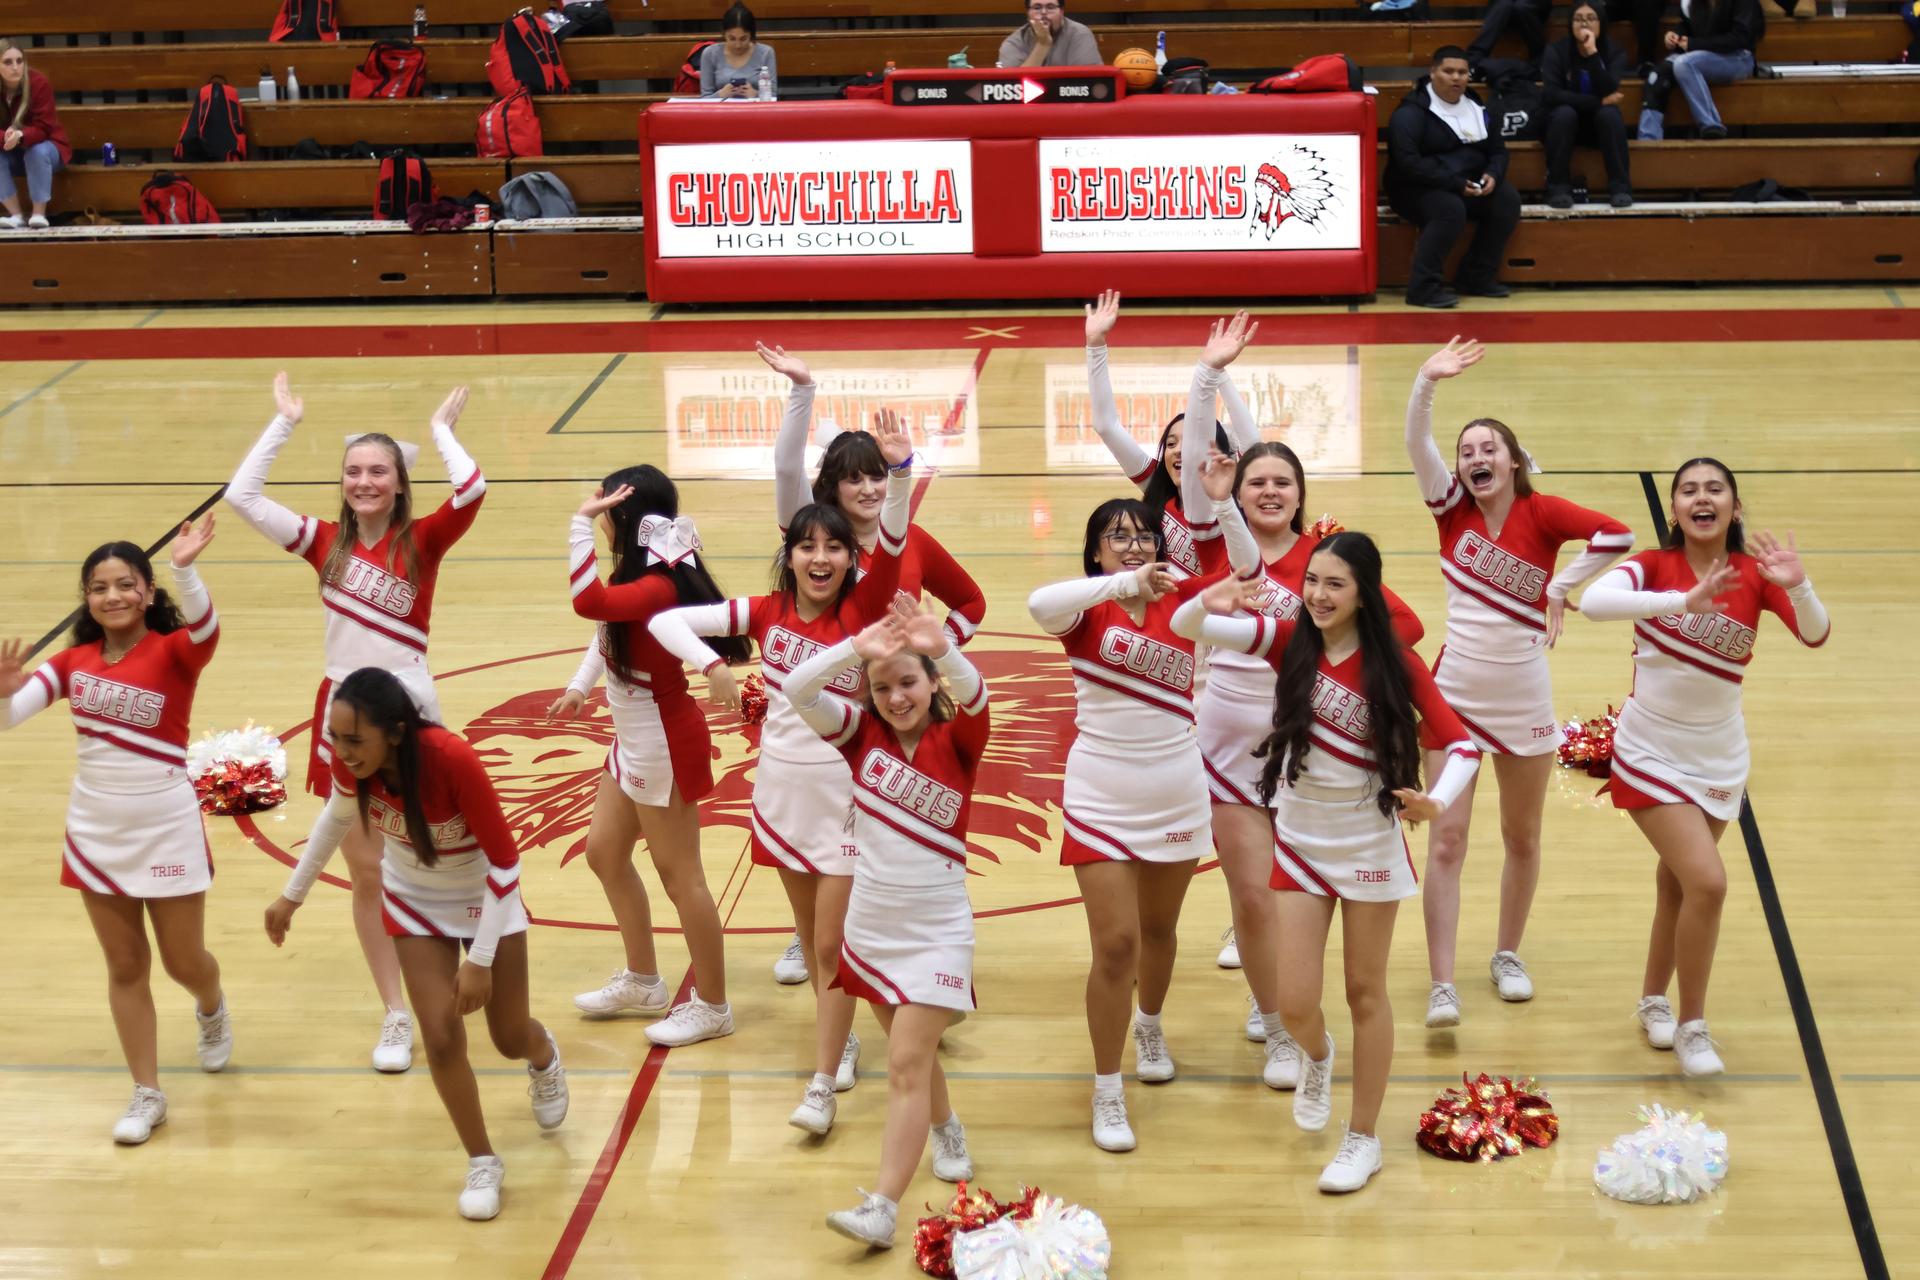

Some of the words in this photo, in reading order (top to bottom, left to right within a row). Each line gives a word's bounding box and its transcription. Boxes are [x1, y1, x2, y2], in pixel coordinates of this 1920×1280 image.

[917, 88, 948, 99] BONUS
[983, 84, 1024, 101] POSS
[1059, 86, 1090, 97] BONUS
[1501, 110, 1529, 136] P
[668, 168, 961, 226] CHOWCHILLA
[1050, 164, 1247, 221] REDSKINS
[717, 232, 784, 248] HIGH
[797, 231, 914, 248] SCHOOL
[1453, 529, 1548, 603] CUHS
[327, 550, 418, 617] UHS
[1099, 626, 1194, 692] CUHS
[70, 671, 165, 728] CUHS
[860, 748, 963, 829] CUHS
[1705, 788, 1731, 801] TRIBE
[1165, 831, 1194, 843] TRIBE
[151, 864, 186, 878] TRIBE
[1355, 869, 1391, 883] TRIBE
[935, 972, 964, 990] TRIBE
